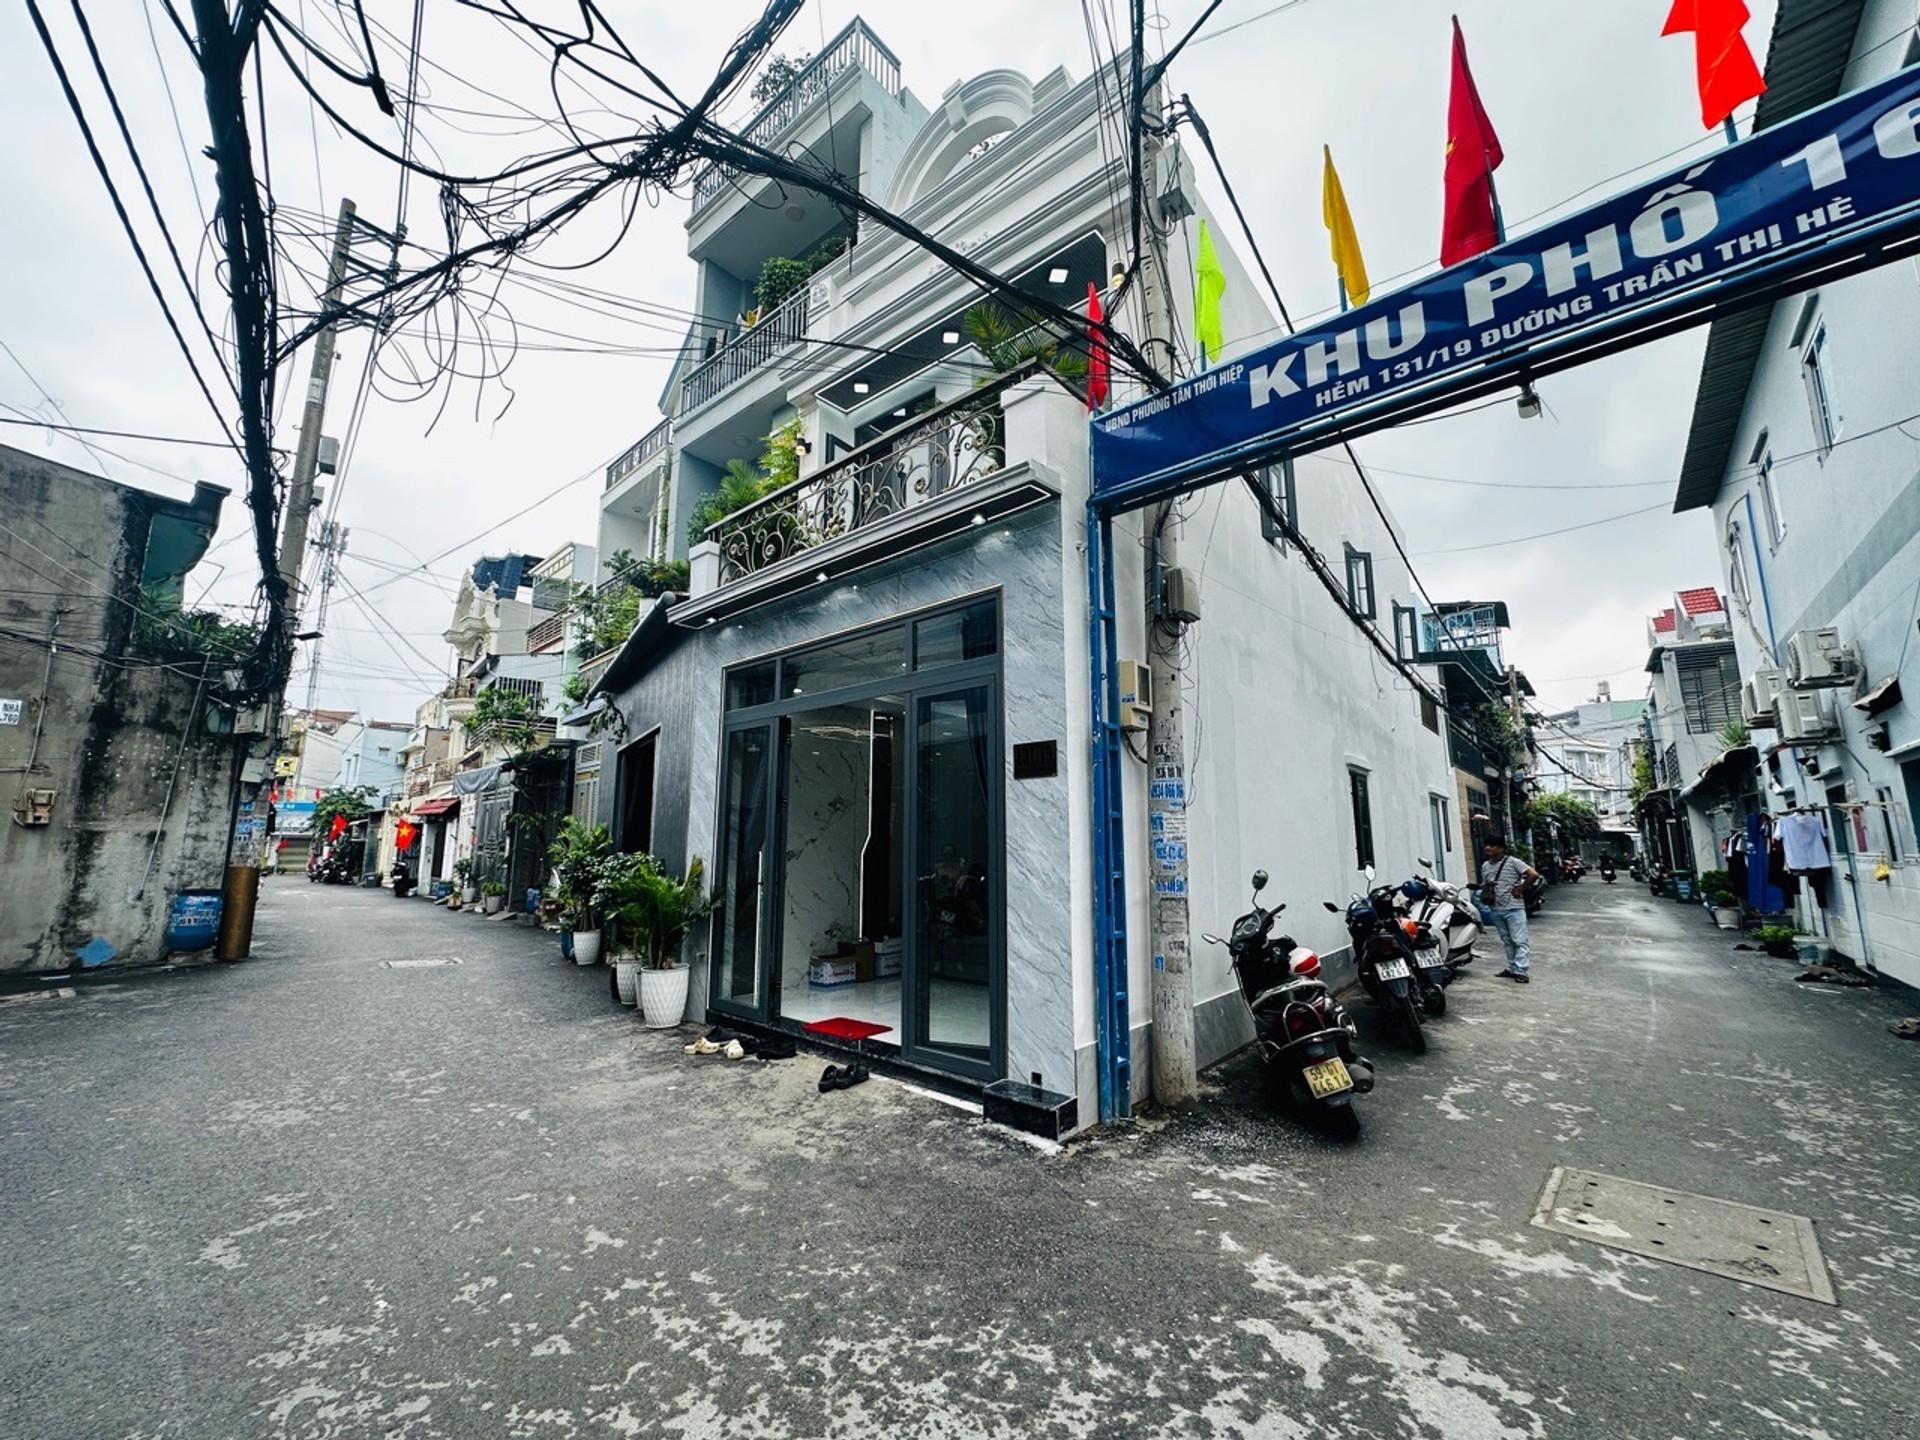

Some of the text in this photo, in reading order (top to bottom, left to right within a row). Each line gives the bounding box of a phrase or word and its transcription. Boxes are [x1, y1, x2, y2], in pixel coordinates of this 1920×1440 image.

[1249, 301, 1427, 410] KHU
[1463, 159, 1720, 328] PHỐ
[1379, 339, 1473, 384] 131/19
[1481, 294, 1594, 349] ĐƯỜNG
[1714, 223, 1783, 262] THỊ
[1795, 196, 1857, 234] HÈ
[1105, 412, 1131, 433] UBND
[1171, 386, 1193, 406] TÂN
[1219, 364, 1245, 386] HIỆP
